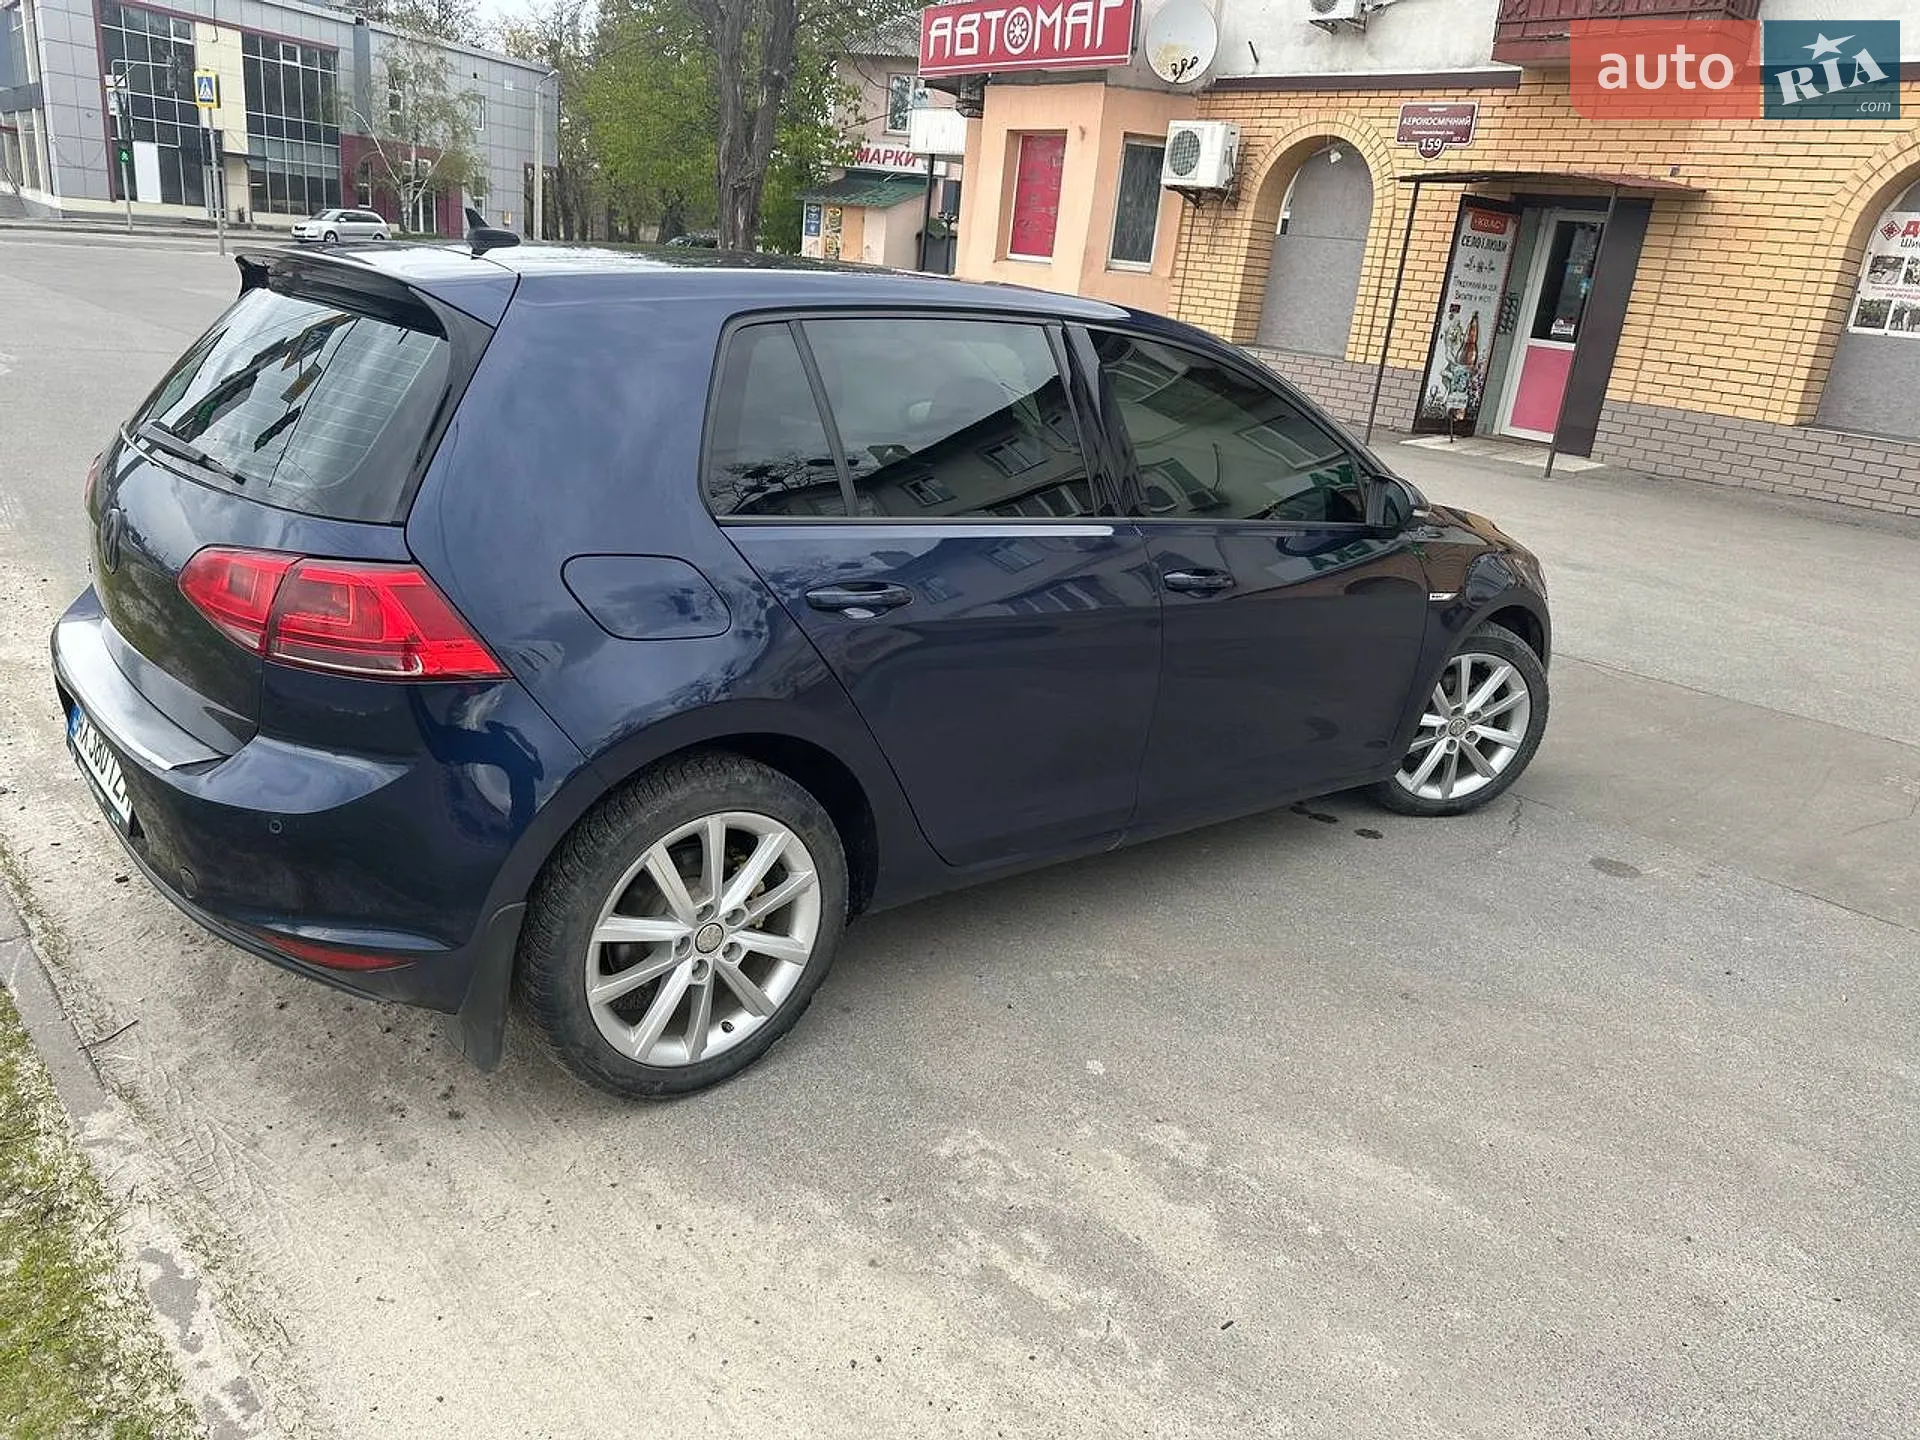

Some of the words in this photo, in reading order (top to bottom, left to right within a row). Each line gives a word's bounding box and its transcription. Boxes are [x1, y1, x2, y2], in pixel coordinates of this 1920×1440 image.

[927, 0, 1124, 61] АВТОМАГ
[1420, 137, 1443, 151] 159
[854, 147, 917, 168] МАРКИ
